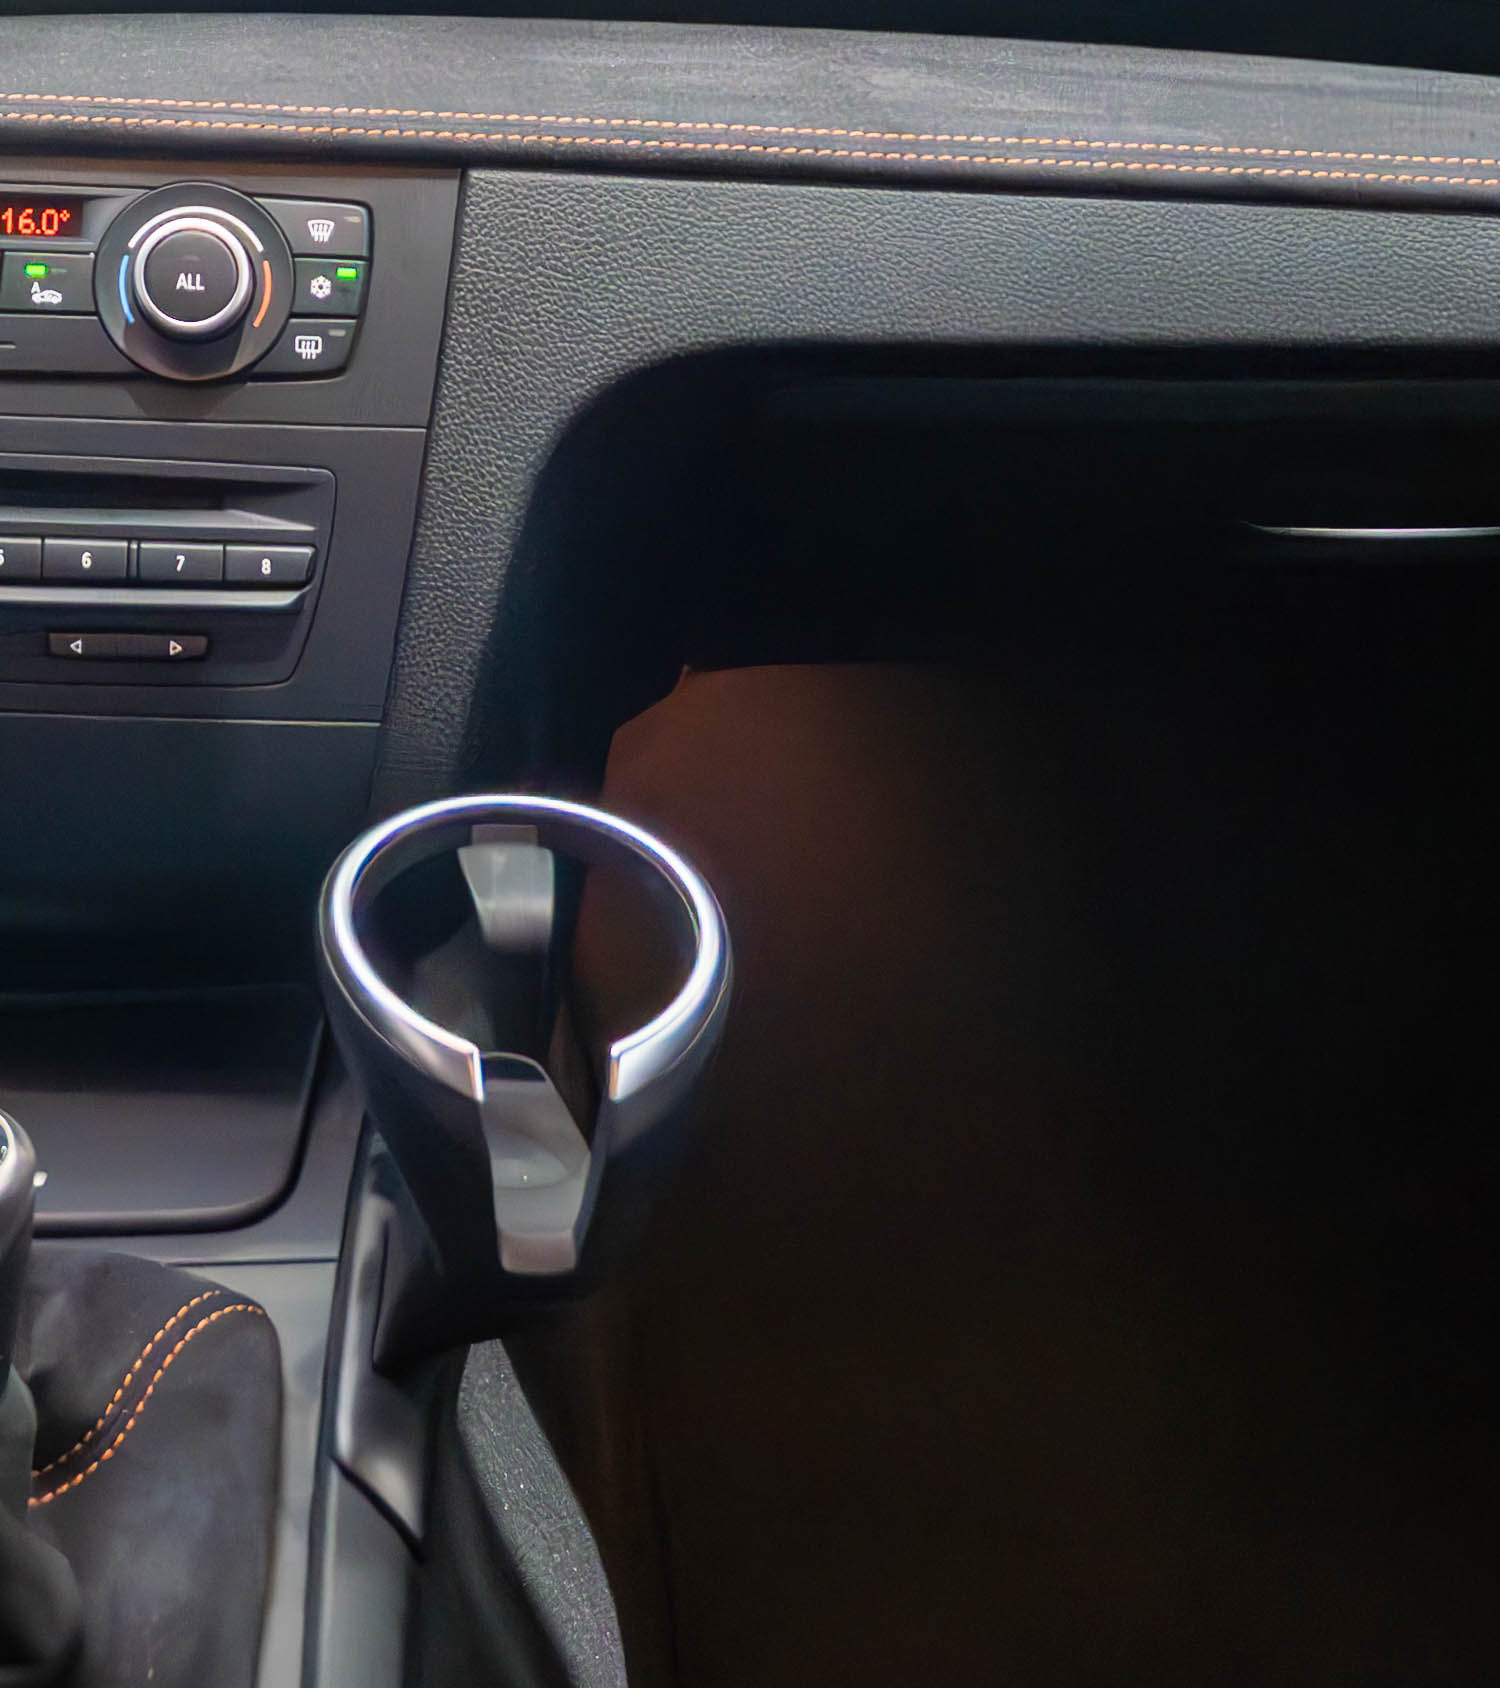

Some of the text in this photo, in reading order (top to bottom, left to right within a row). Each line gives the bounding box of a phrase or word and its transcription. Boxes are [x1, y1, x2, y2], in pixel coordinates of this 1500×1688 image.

[175, 272, 206, 291] ALL
[81, 551, 92, 569] 6
[175, 555, 186, 573] 7
[261, 558, 272, 575] 8
